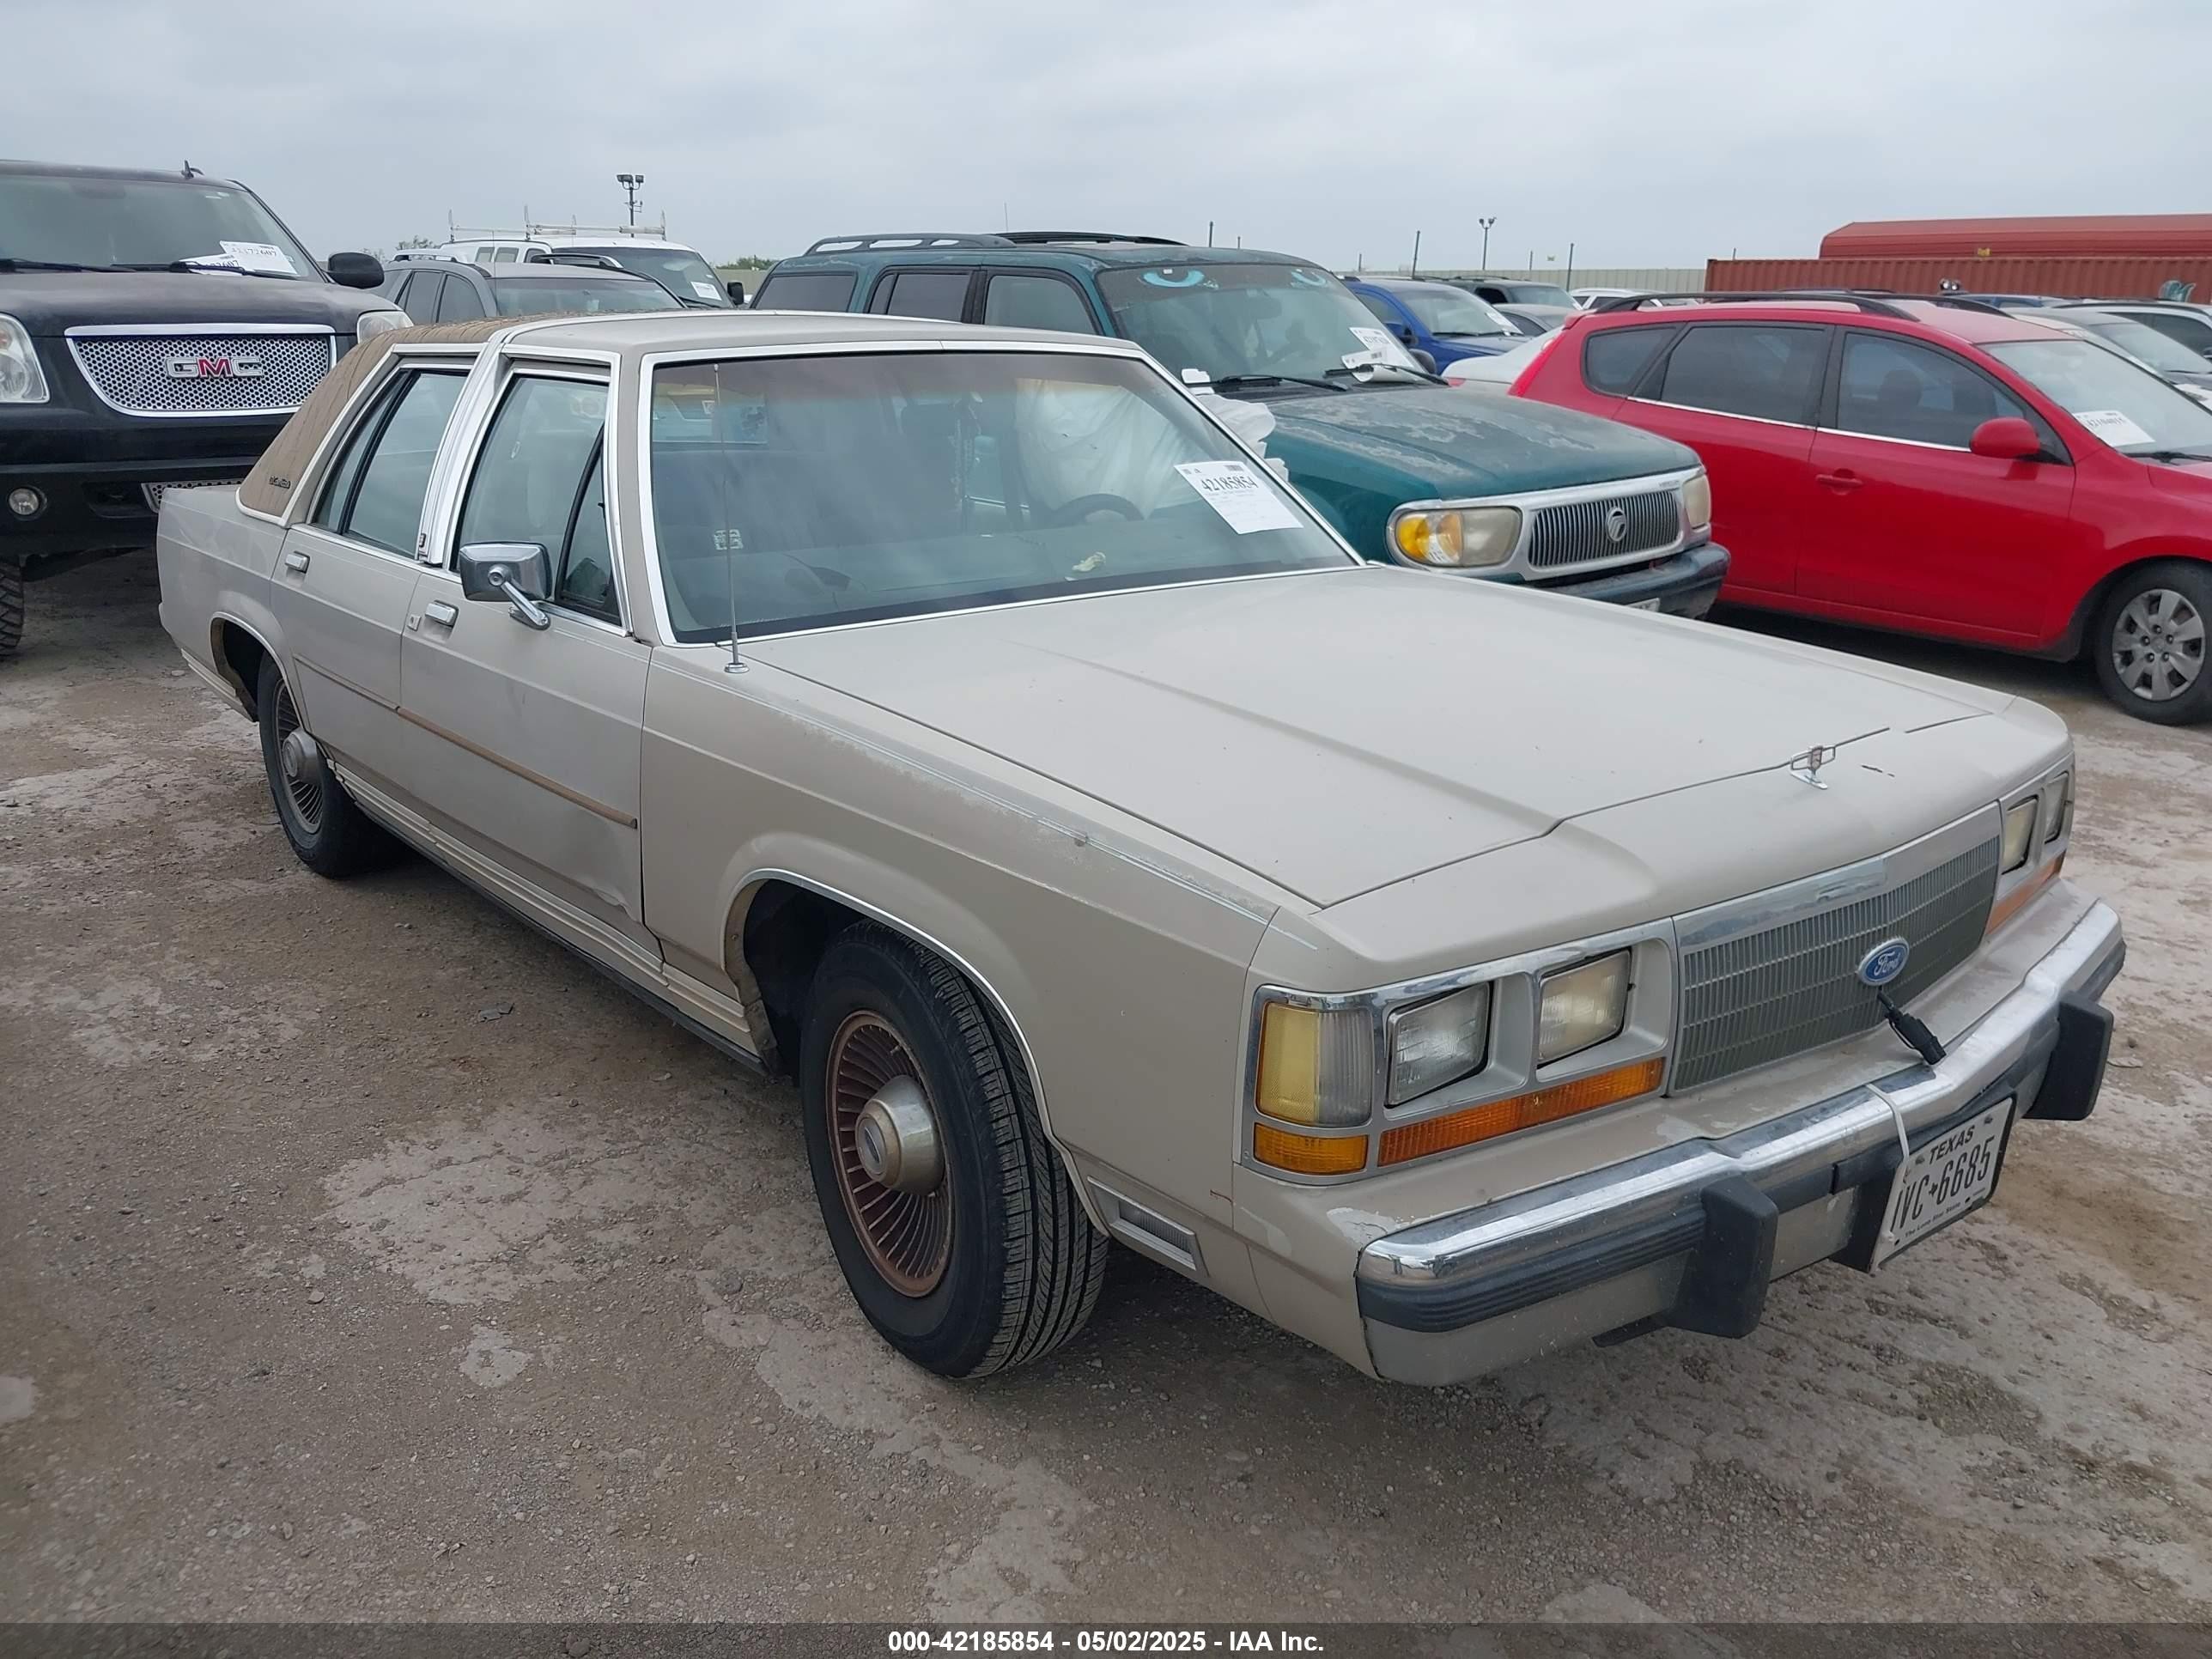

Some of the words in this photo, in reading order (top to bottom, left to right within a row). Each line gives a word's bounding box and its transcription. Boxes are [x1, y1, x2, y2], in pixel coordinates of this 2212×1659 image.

[166, 357, 263, 378] GMC
[1201, 475, 1259, 492] 42185854
[1874, 951, 1901, 976] Ford
[1929, 1126, 1975, 1164] TEXAS
